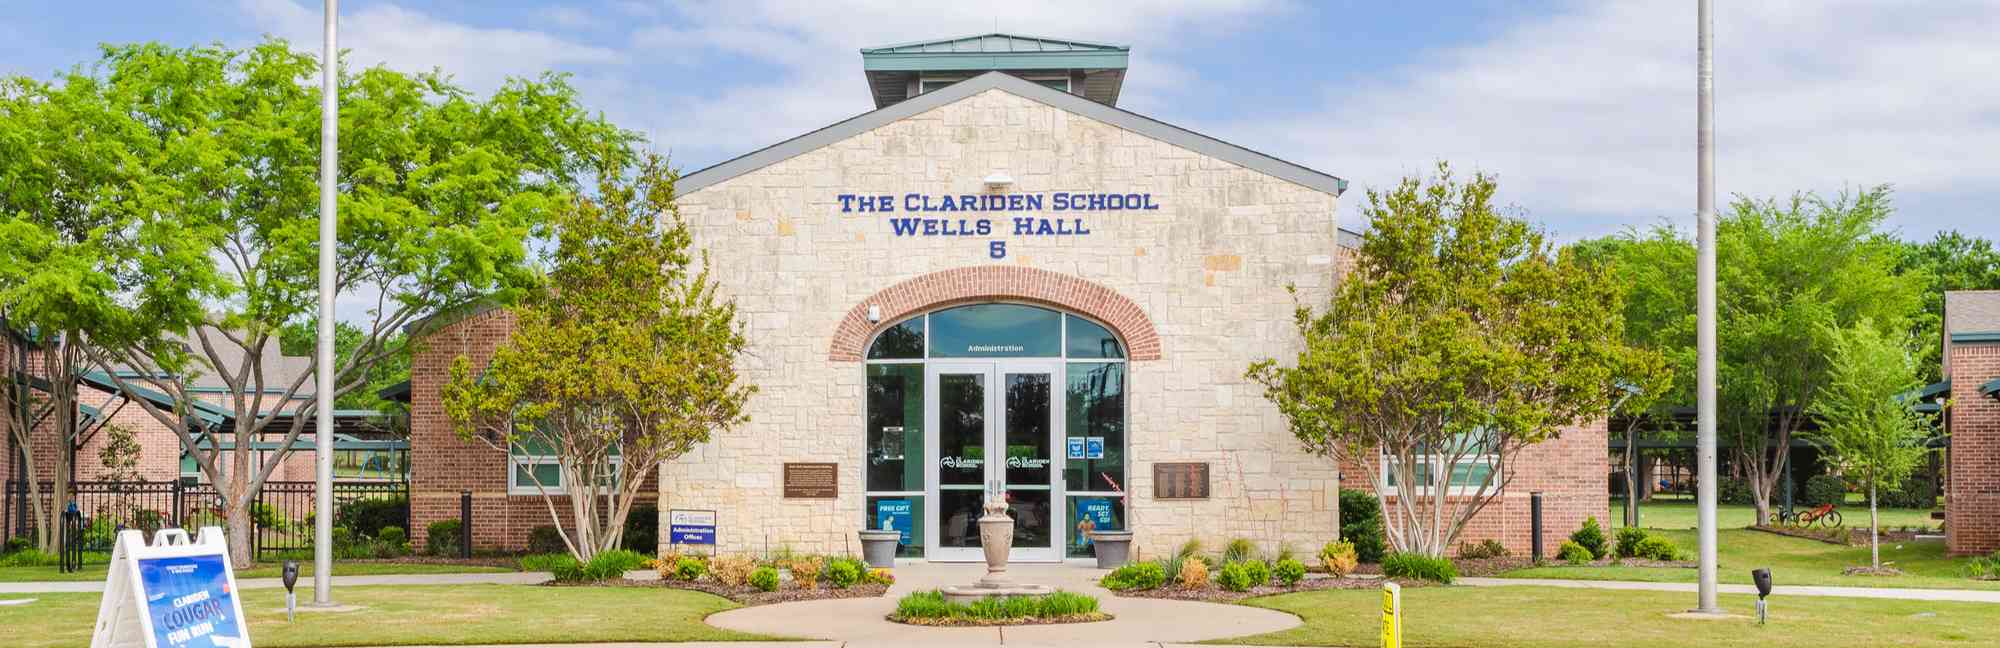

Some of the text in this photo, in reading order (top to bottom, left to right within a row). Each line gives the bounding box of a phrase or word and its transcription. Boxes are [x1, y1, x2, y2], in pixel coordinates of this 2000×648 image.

[837, 192, 1159, 212] THE CLARIDEN SCHOOL
[889, 217, 1091, 236] WELLS HALL
[989, 240, 1006, 258] 5
[967, 343, 1024, 352] Administration
[162, 598, 224, 631] COUGAR
[167, 628, 192, 646] FUN
